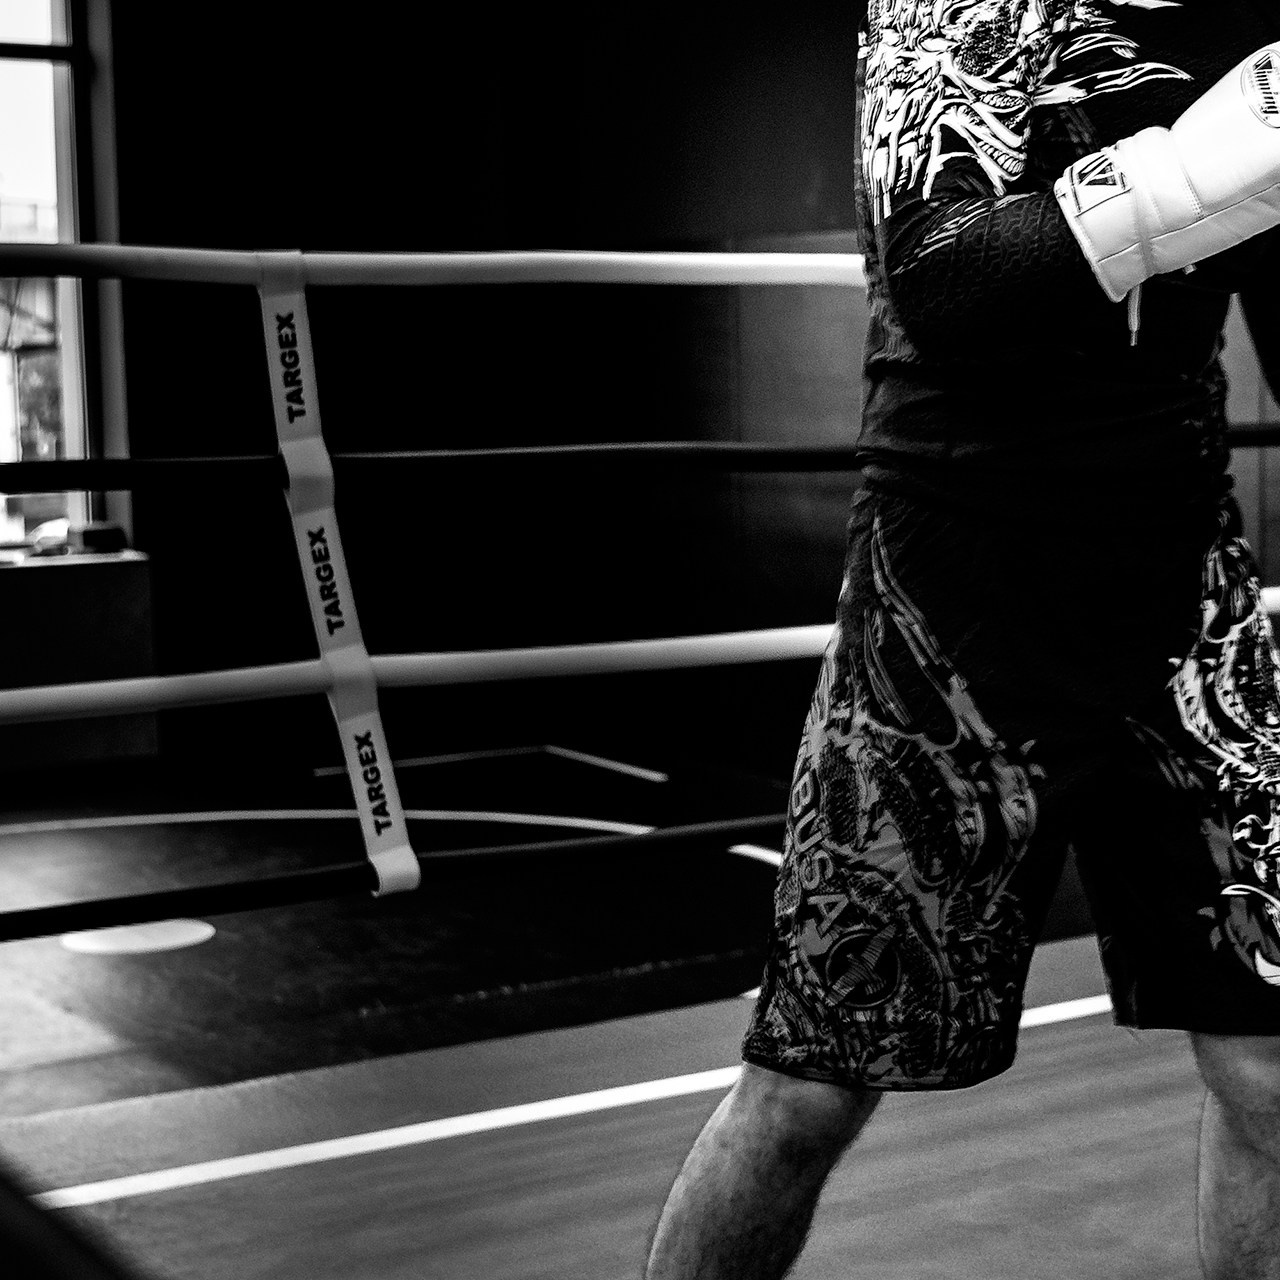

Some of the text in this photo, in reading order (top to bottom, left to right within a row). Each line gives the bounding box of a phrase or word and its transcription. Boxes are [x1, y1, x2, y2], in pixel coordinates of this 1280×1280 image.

[275, 311, 307, 424] TARGEX
[306, 526, 346, 637] TARGEX
[353, 731, 393, 837] TARGEX
[791, 750, 849, 937] BUSA
